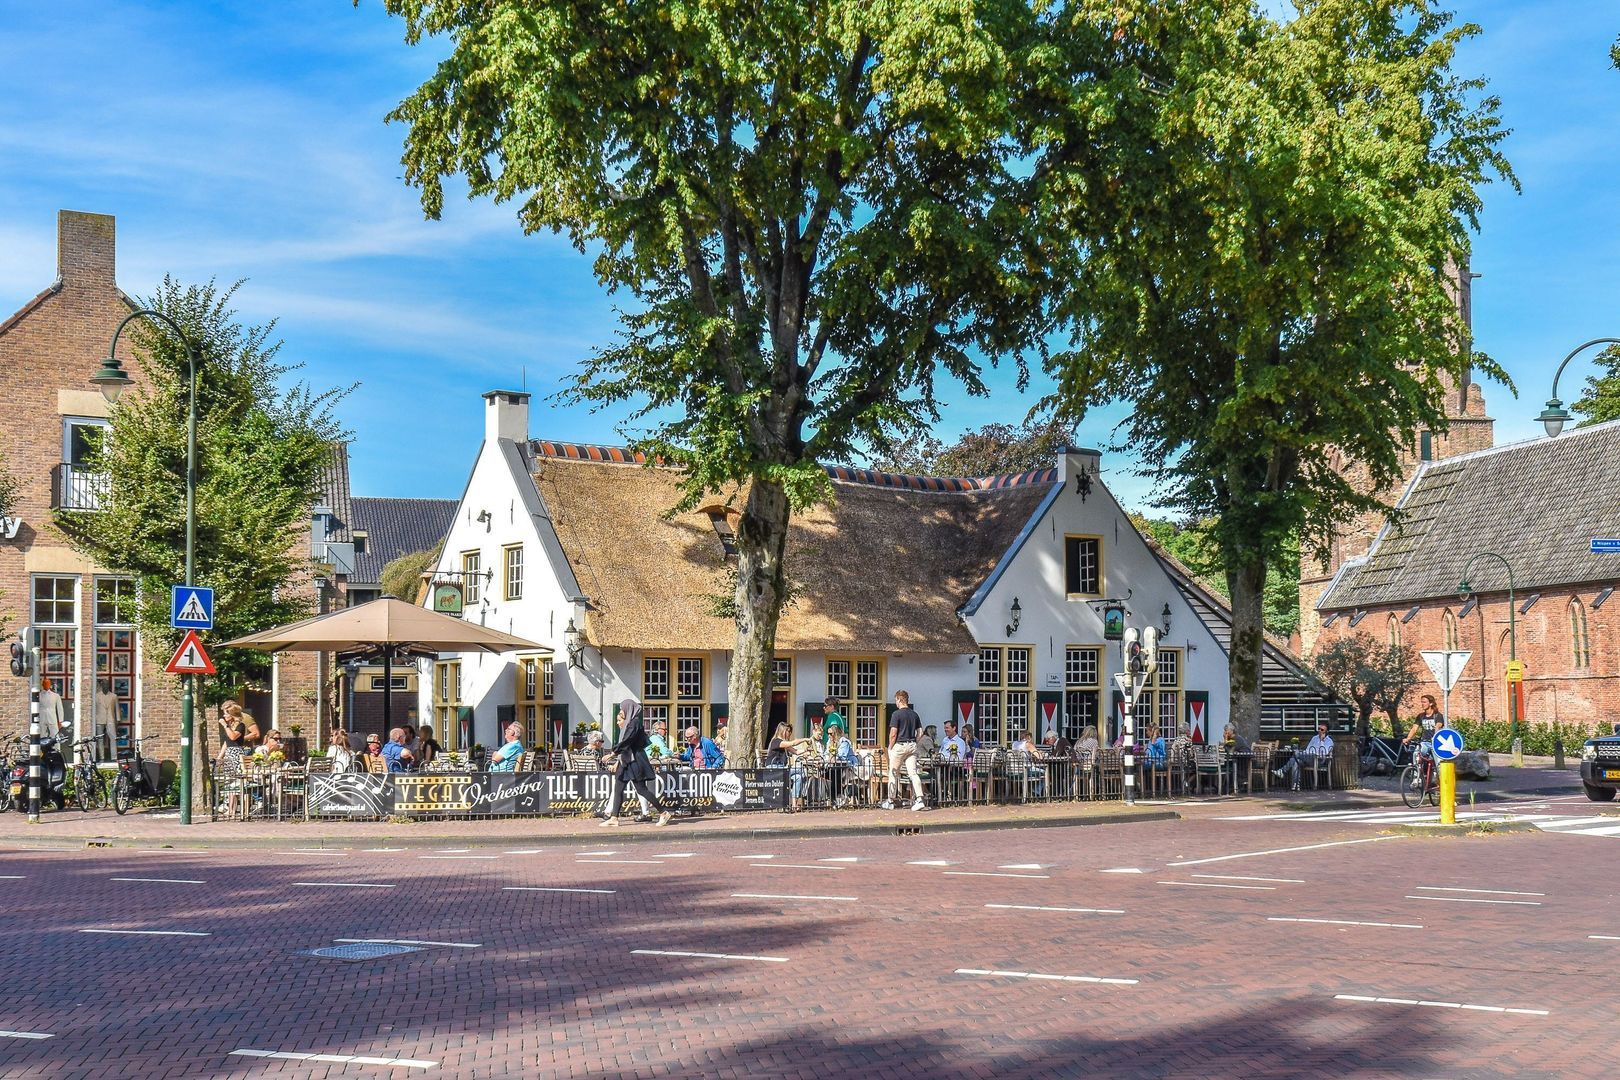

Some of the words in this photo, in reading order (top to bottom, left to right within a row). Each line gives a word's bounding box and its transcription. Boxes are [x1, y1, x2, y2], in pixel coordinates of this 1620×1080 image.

[0, 516, 22, 539] y
[401, 784, 464, 803] VEGAS
[462, 781, 544, 809] Orchestra
[546, 774, 579, 800] THE
[655, 773, 712, 799] DREAM
[714, 781, 739, 791] gratis
[547, 796, 596, 812] zondag
[680, 796, 713, 807] 2023
